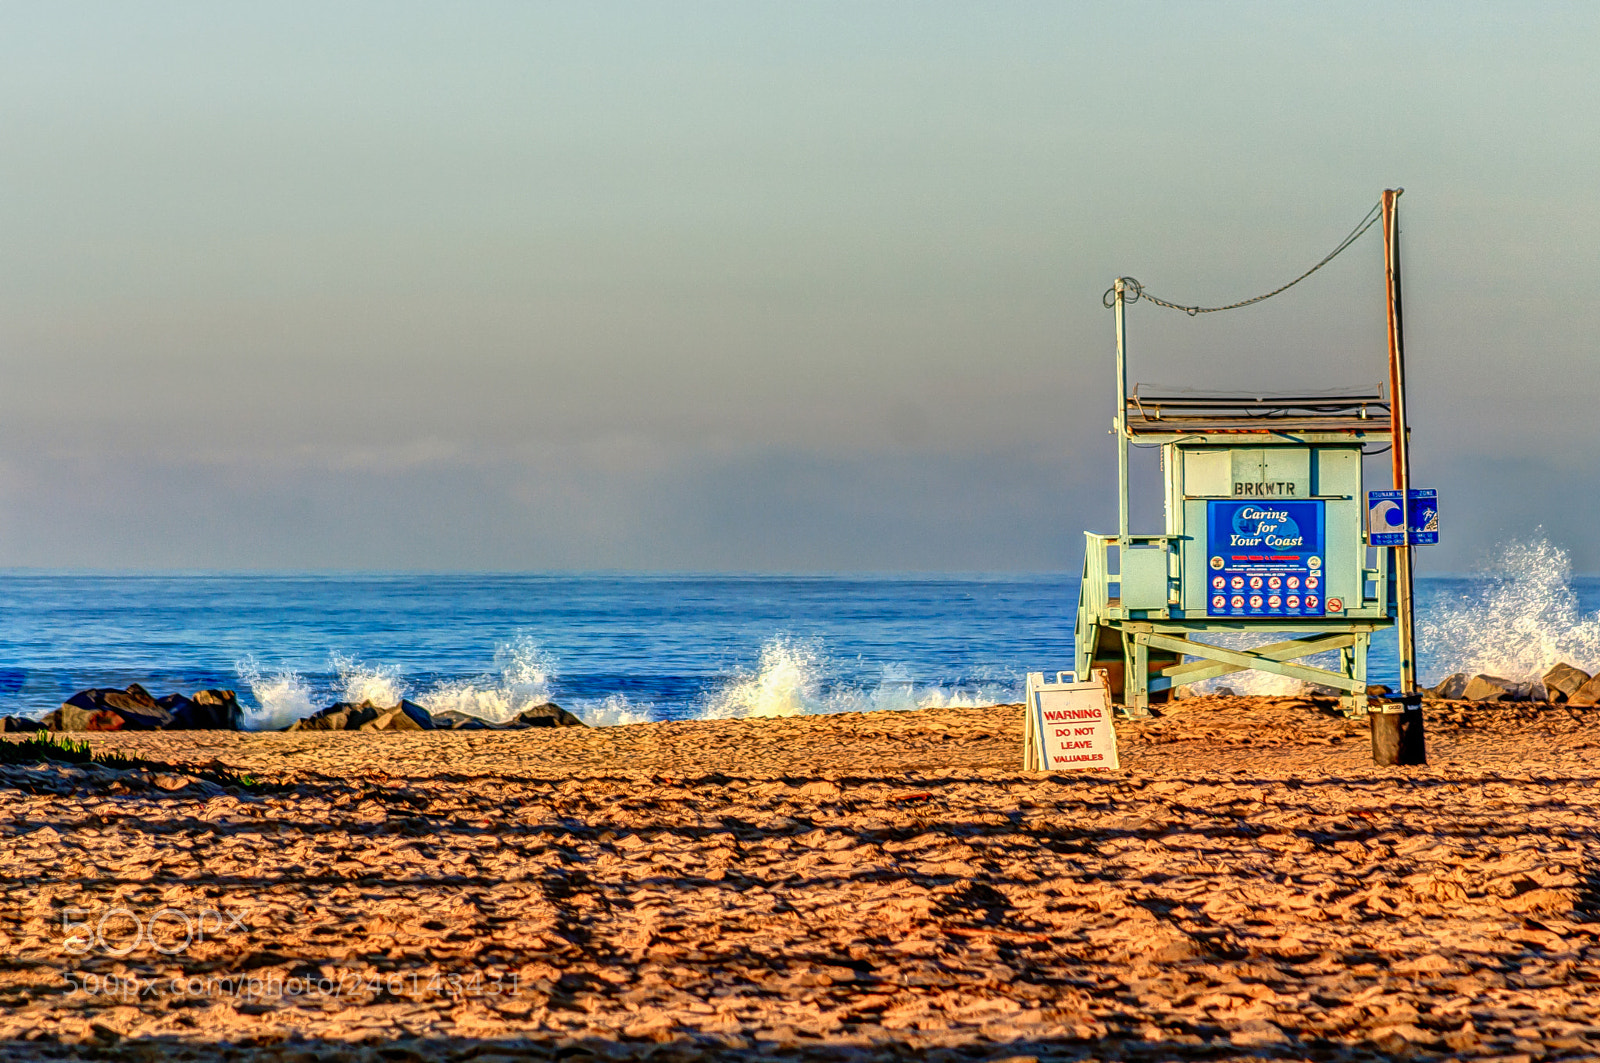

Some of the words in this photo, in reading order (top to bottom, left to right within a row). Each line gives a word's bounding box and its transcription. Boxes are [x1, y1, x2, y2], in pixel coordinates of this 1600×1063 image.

[1234, 482, 1295, 495] BRKWTR
[1242, 507, 1288, 523] Caring
[1253, 521, 1278, 536] for
[1230, 534, 1262, 546] Your
[1264, 534, 1303, 546] Coast
[1043, 708, 1102, 721] WARNING
[1055, 728, 1071, 737] DO
[1074, 727, 1095, 736] NOT
[1060, 740, 1093, 750] LEAVE
[1053, 753, 1104, 763] VALUABLES
